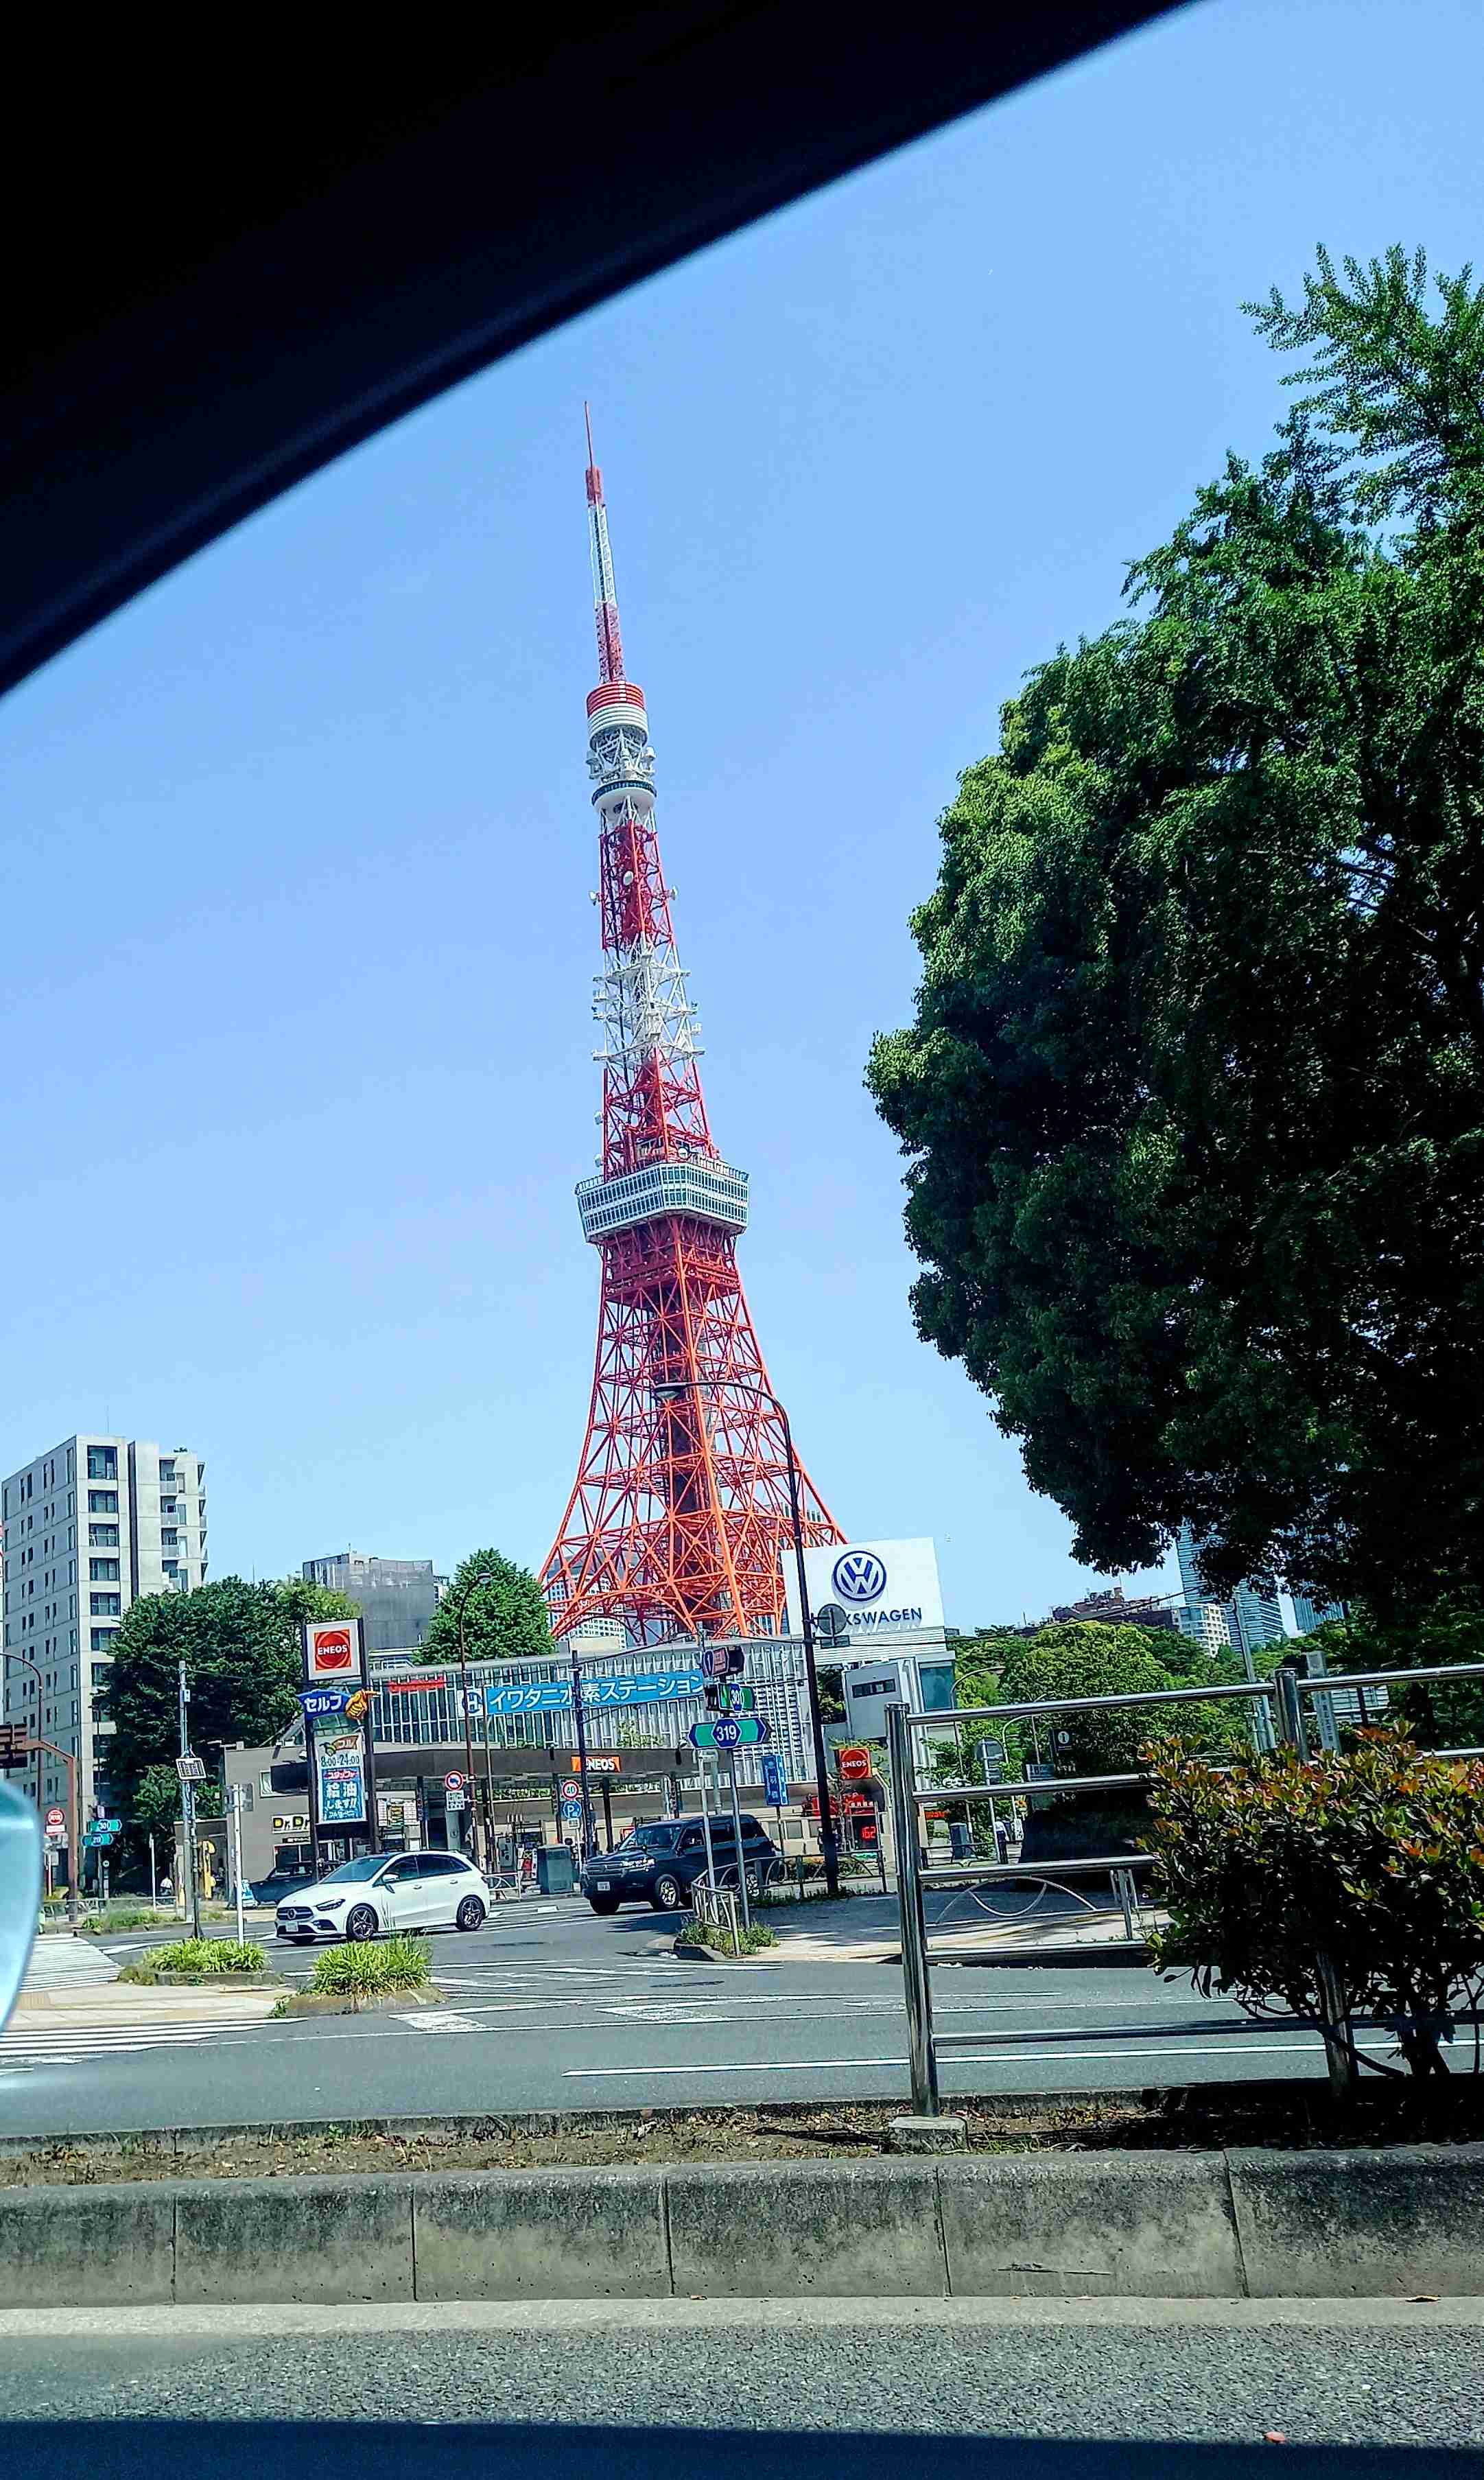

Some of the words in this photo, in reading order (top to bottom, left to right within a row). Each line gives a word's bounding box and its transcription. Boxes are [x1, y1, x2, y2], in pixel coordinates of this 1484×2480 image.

[845, 1607, 923, 1626] KSWAGEN
[317, 1644, 348, 1655] ENEOS
[304, 1695, 342, 1713] セルフ
[716, 1724, 737, 1741] 319
[841, 1759, 867, 1768] ENEOS
[326, 1781, 357, 1799] 給油
[567, 1805, 574, 1818] P
[272, 1816, 307, 1829] Dr.Dr
